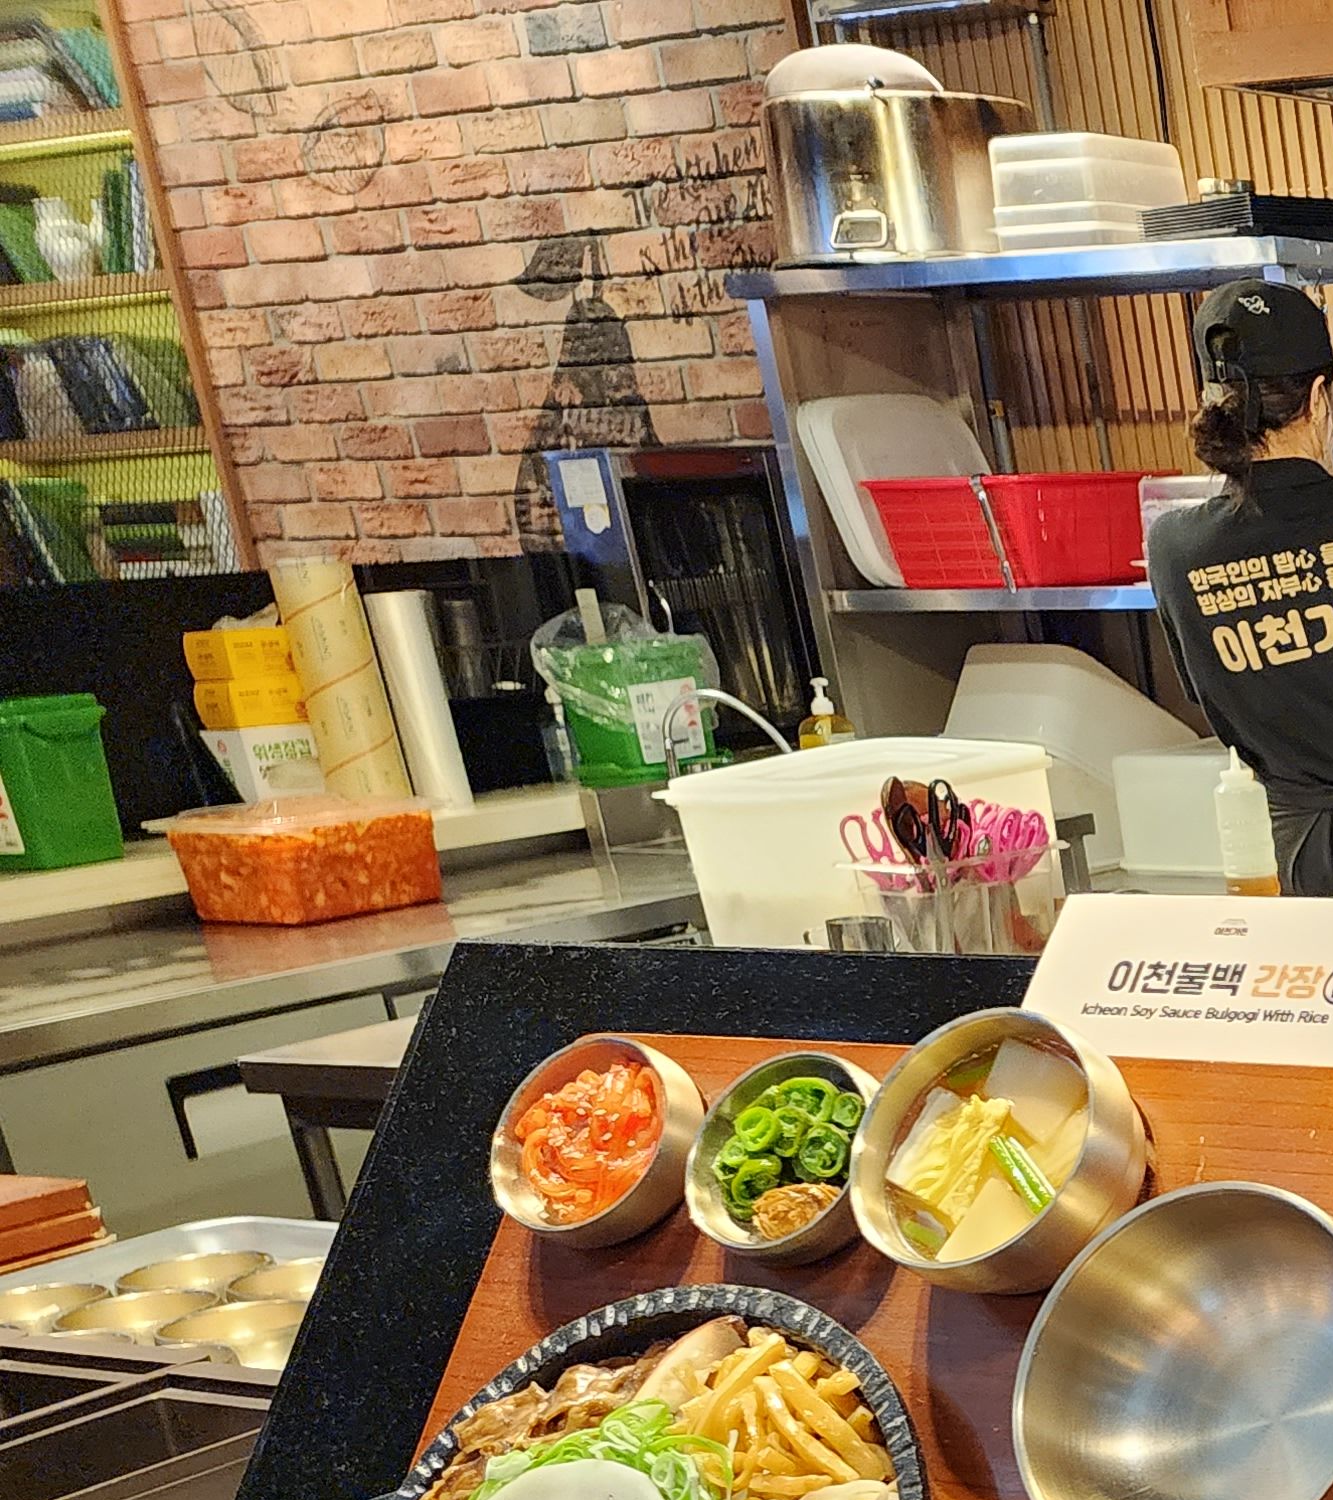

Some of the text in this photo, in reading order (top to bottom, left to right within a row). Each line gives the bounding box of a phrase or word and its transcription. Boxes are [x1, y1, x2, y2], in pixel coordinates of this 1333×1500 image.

[1188, 555, 1270, 592] 한국인의
[1196, 584, 1257, 616] 밥상의
[1107, 960, 1327, 999] 이천불백 간장
[1081, 1002, 1329, 1024] Icheon Soy Sauce Bulgogi With Rice
